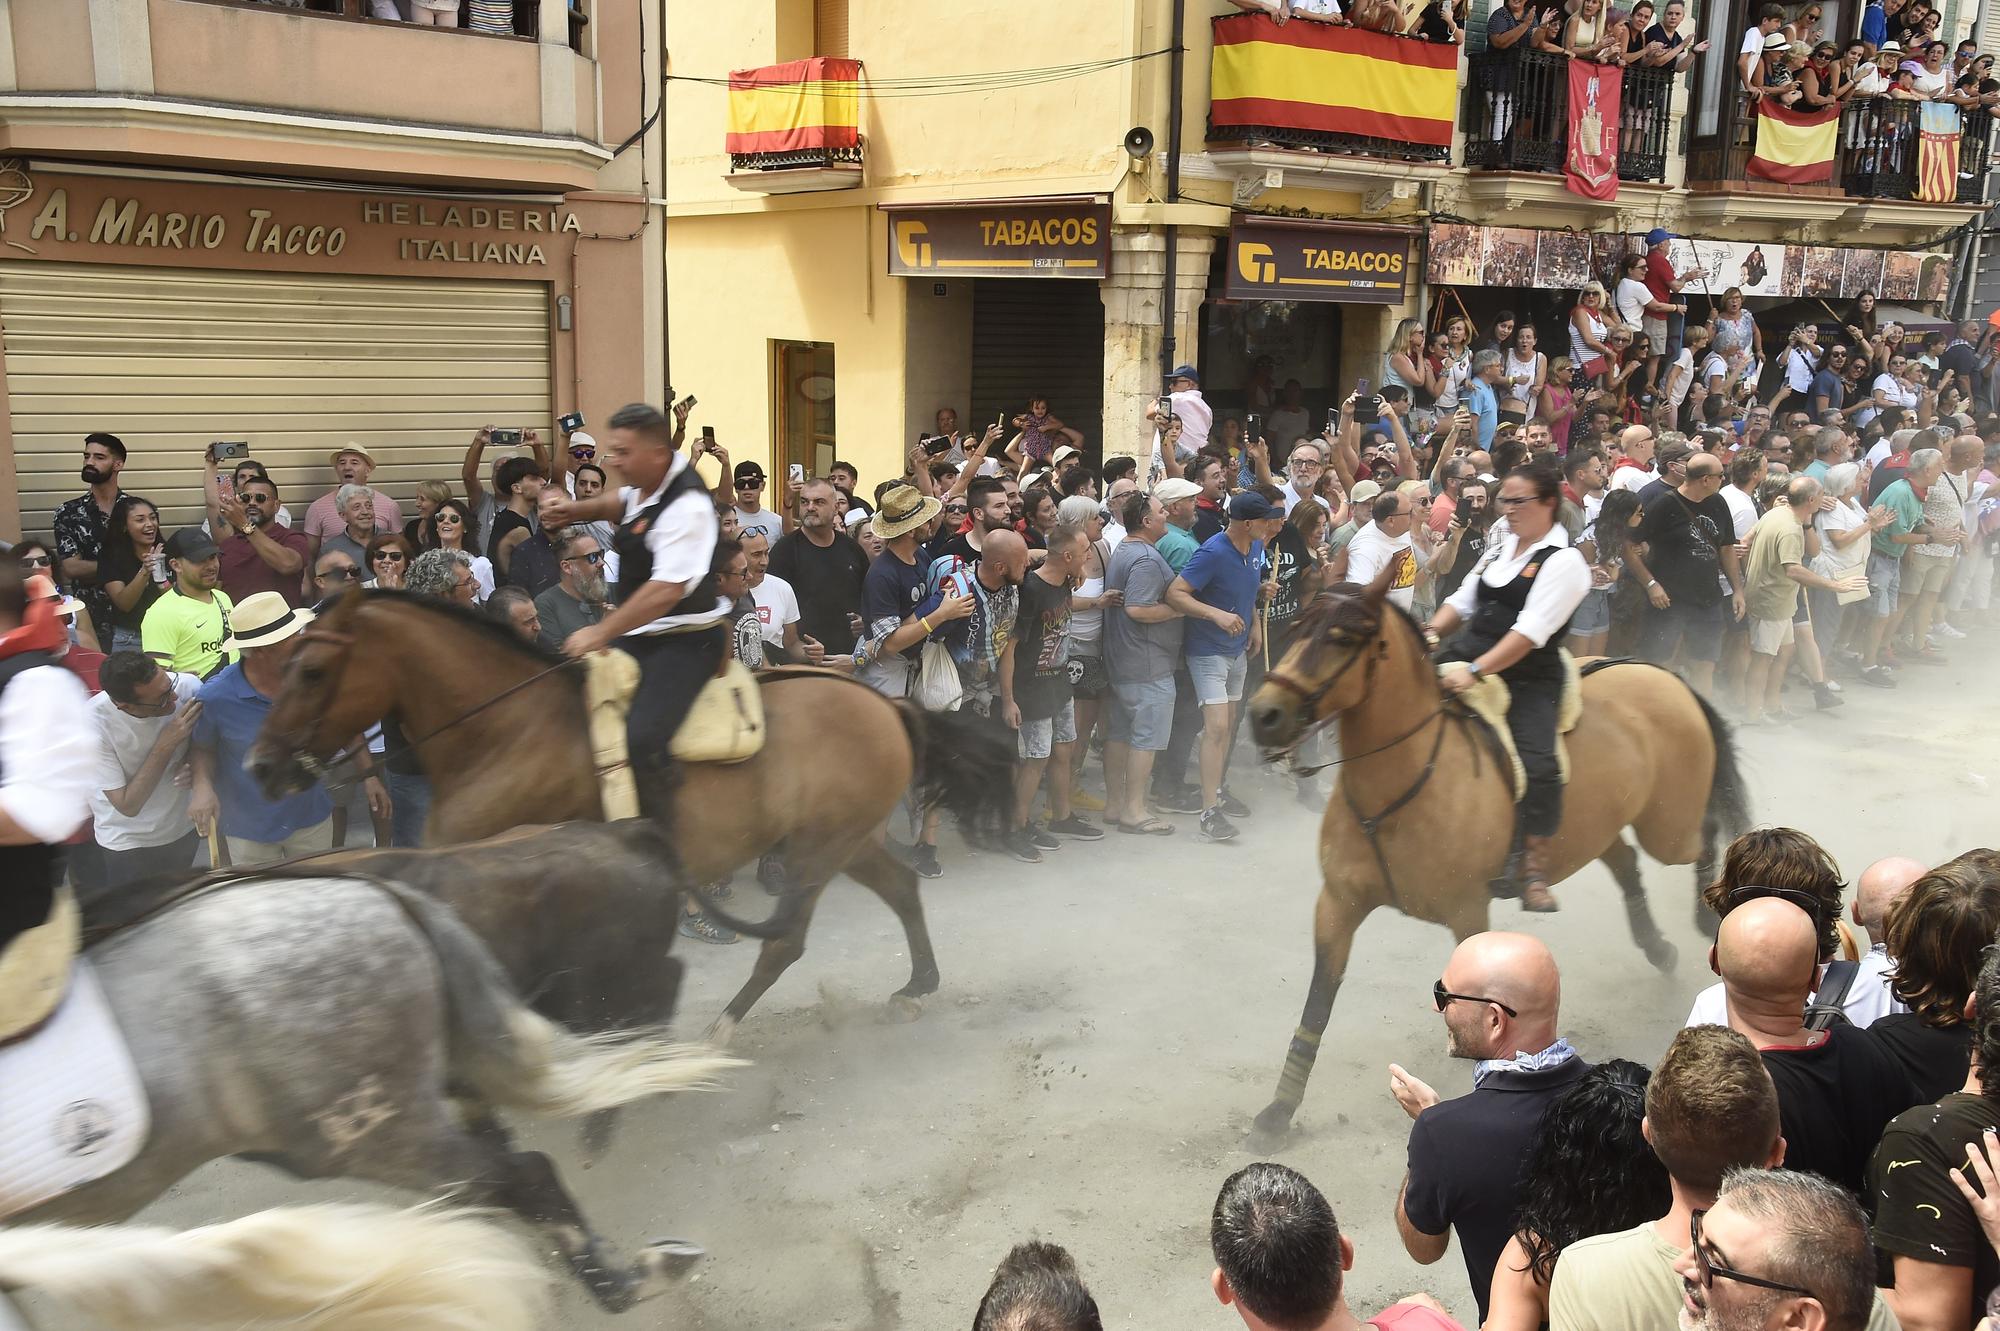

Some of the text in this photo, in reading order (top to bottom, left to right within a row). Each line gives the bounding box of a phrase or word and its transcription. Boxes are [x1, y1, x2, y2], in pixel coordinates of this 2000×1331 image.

[30, 187, 78, 242] A.
[363, 201, 582, 233] HELADERIA
[980, 217, 1098, 246] TABACOS
[400, 238, 547, 265] ITALIANA
[1302, 248, 1403, 273] TABACOS
